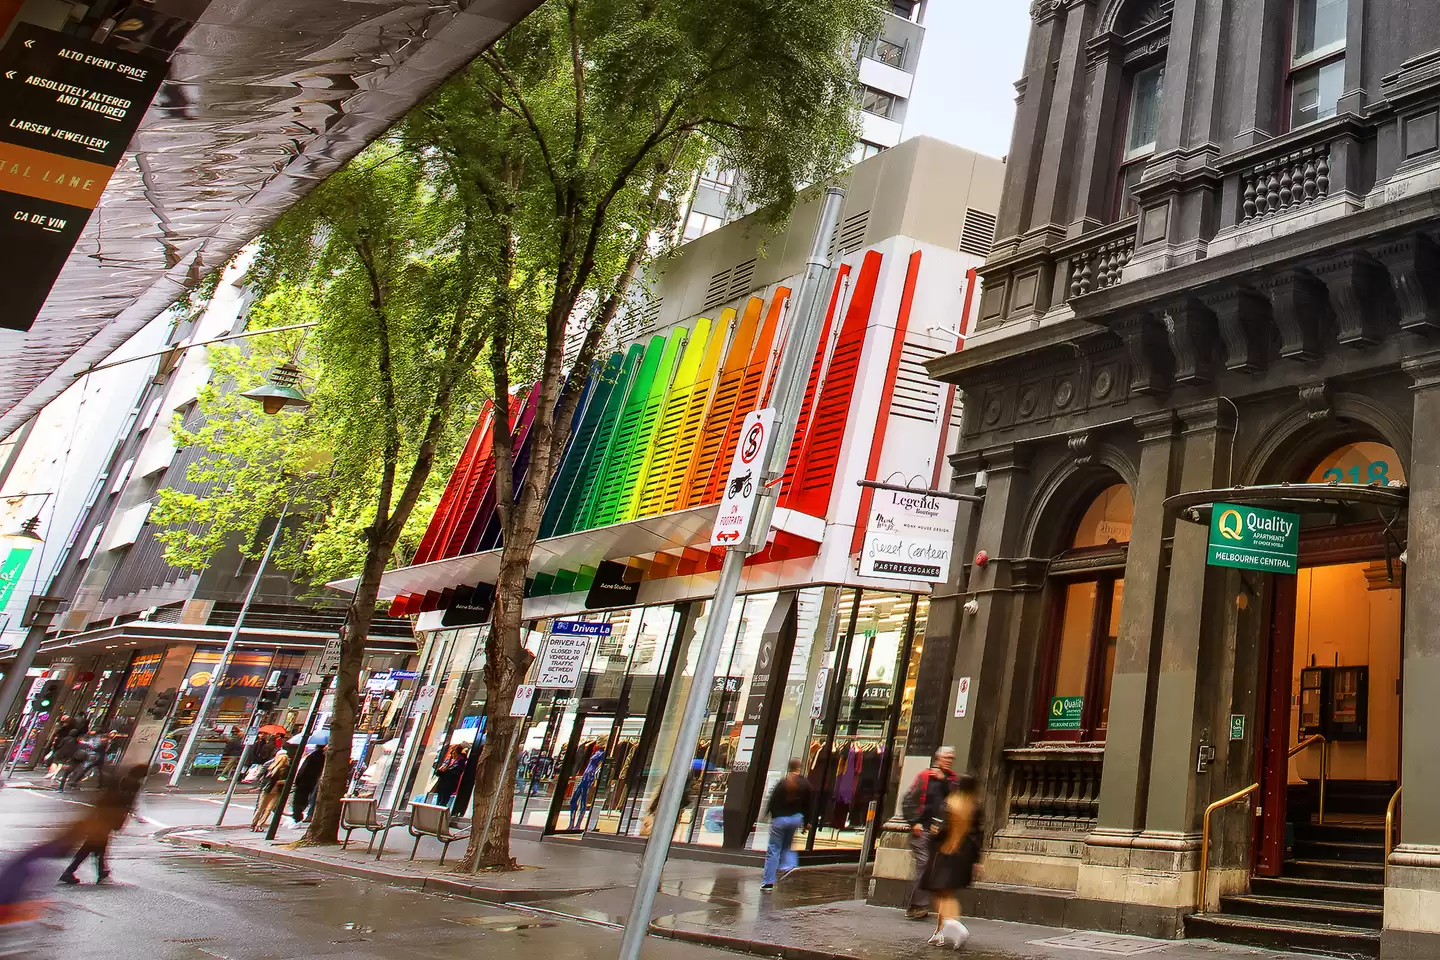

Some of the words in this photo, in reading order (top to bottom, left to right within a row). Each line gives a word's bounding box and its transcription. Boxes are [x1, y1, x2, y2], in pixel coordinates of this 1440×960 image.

[58, 48, 84, 61] ALTO
[84, 55, 117, 70] EVENT
[117, 63, 148, 79] SPACE
[25, 75, 90, 98] ABSOLUTELY
[89, 91, 131, 109] ALTERED
[56, 94, 79, 107] AND
[80, 99, 126, 118] TAILORED
[9, 118, 51, 135] LARSEN
[51, 128, 110, 149] JEWELLERY
[14, 210, 29, 222] CA
[30, 214, 47, 225] DE
[47, 217, 67, 229] VIN
[892, 492, 940, 511] Legends
[915, 508, 939, 518] Boutique
[1246, 512, 1293, 537] Quality
[1252, 532, 1285, 542] APARTMENTS
[869, 538, 903, 558] Sweet
[907, 543, 949, 560] Canteen
[874, 562, 940, 575] PASTRIES&CAKES
[1215, 551, 1259, 564] MELBOURNE
[1260, 557, 1291, 568] CENTRAL
[572, 624, 598, 633] Driver
[600, 624, 610, 634] La
